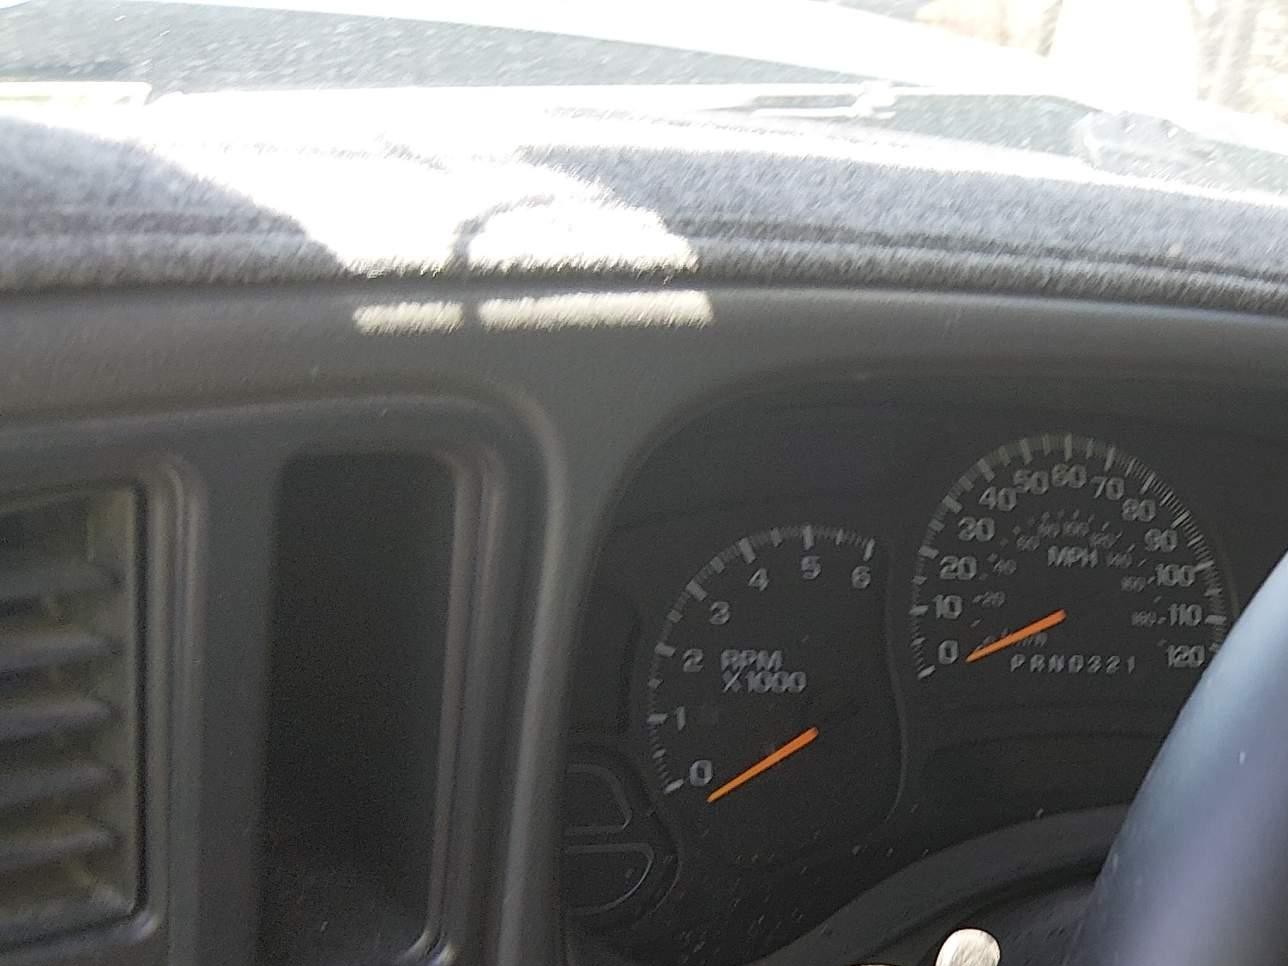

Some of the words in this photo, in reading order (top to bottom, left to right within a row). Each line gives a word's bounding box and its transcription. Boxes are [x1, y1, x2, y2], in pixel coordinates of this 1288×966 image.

[1013, 470, 1049, 495] 50
[1052, 463, 1087, 488] 60
[1090, 475, 1125, 500] 70
[978, 486, 1017, 511] 40
[1122, 498, 1157, 522] 80
[958, 517, 995, 541] 30
[1144, 528, 1178, 553] 90
[801, 555, 822, 579] 5
[940, 555, 977, 580] 20
[1047, 545, 1099, 568] MPH
[749, 567, 770, 592] 4
[851, 565, 872, 589] 6
[1155, 563, 1195, 587] 100
[709, 601, 731, 625] 3
[934, 594, 962, 620] 10
[1167, 603, 1202, 627] 110
[682, 649, 703, 673] 2
[720, 650, 784, 671] RPM
[938, 640, 959, 664] 0
[1166, 645, 1206, 668] 120
[674, 705, 687, 731] 1
[689, 759, 714, 787] 0
